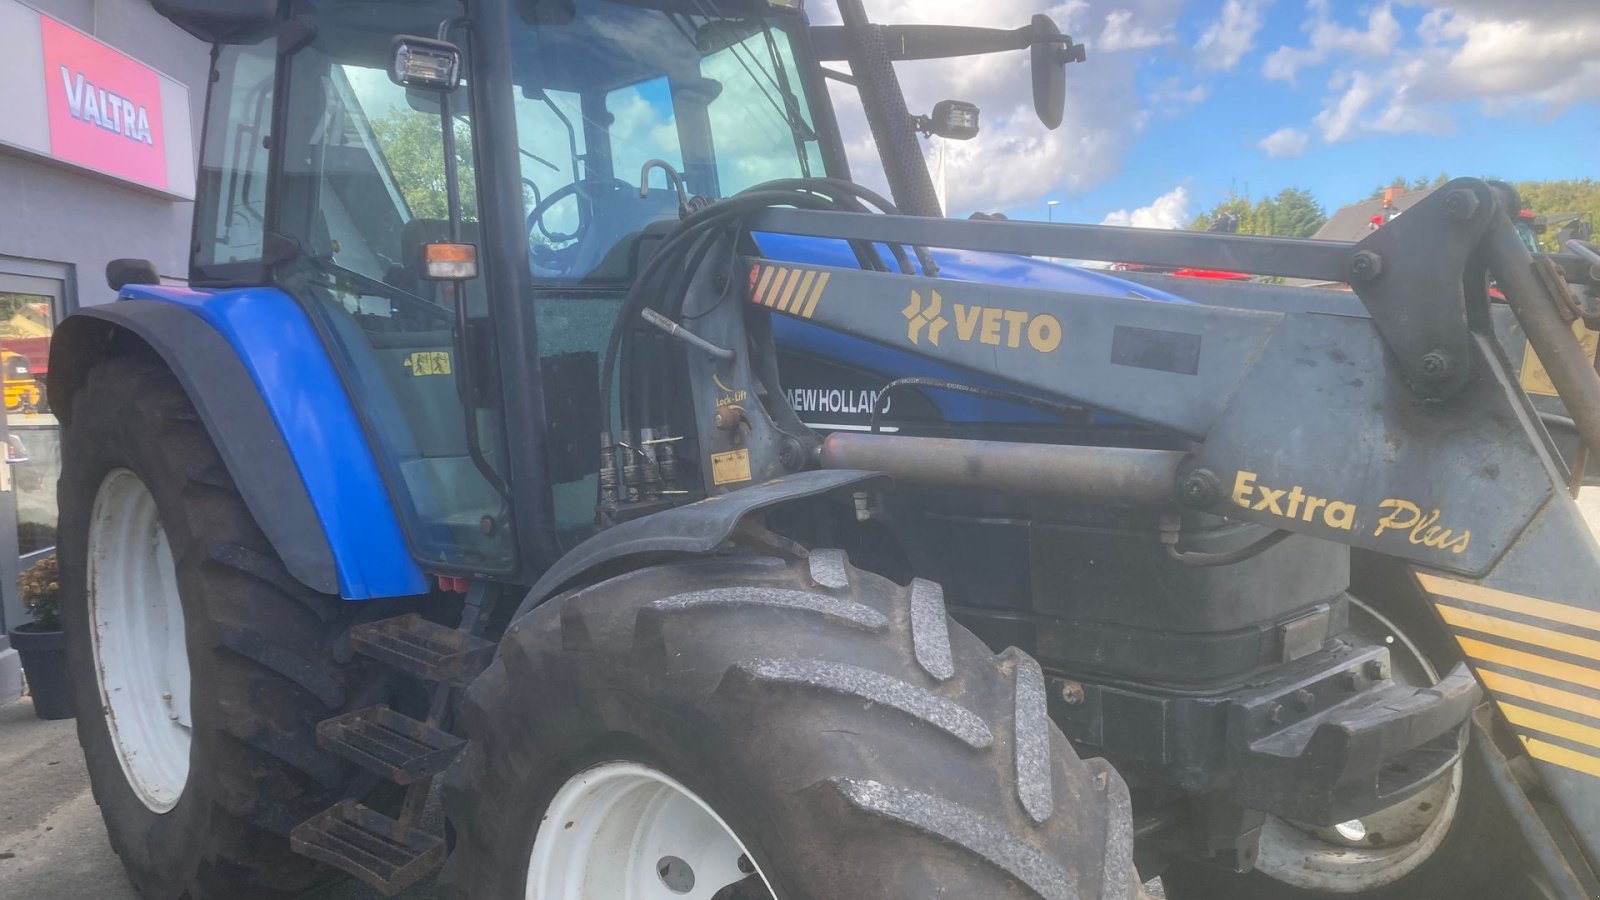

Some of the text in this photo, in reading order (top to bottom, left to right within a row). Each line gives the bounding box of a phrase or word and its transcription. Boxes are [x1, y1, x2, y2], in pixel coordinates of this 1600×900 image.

[60, 65, 153, 146] VALTRA
[953, 303, 1062, 353] VETO
[1232, 470, 1471, 553] Extra Plus
